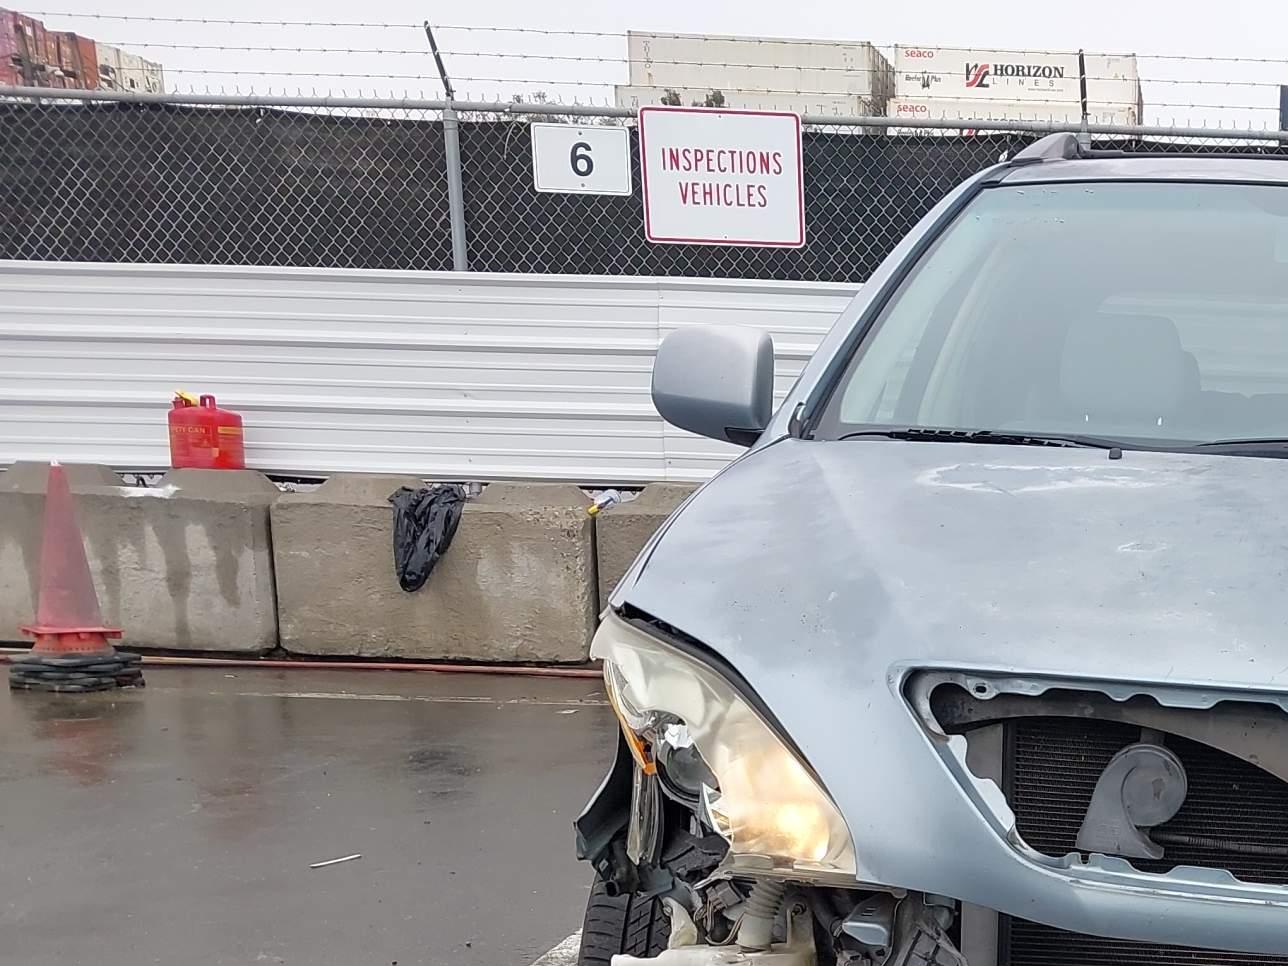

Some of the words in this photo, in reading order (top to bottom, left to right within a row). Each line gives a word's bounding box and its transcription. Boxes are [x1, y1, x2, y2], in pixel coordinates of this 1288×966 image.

[904, 49, 934, 58] seaco
[992, 63, 1065, 79] HORIZON
[992, 78, 1055, 87] LINES
[897, 104, 928, 113] seaco
[570, 142, 594, 177] 6
[661, 147, 783, 176] INSPECTIONS
[678, 181, 768, 208] VEHICLES
